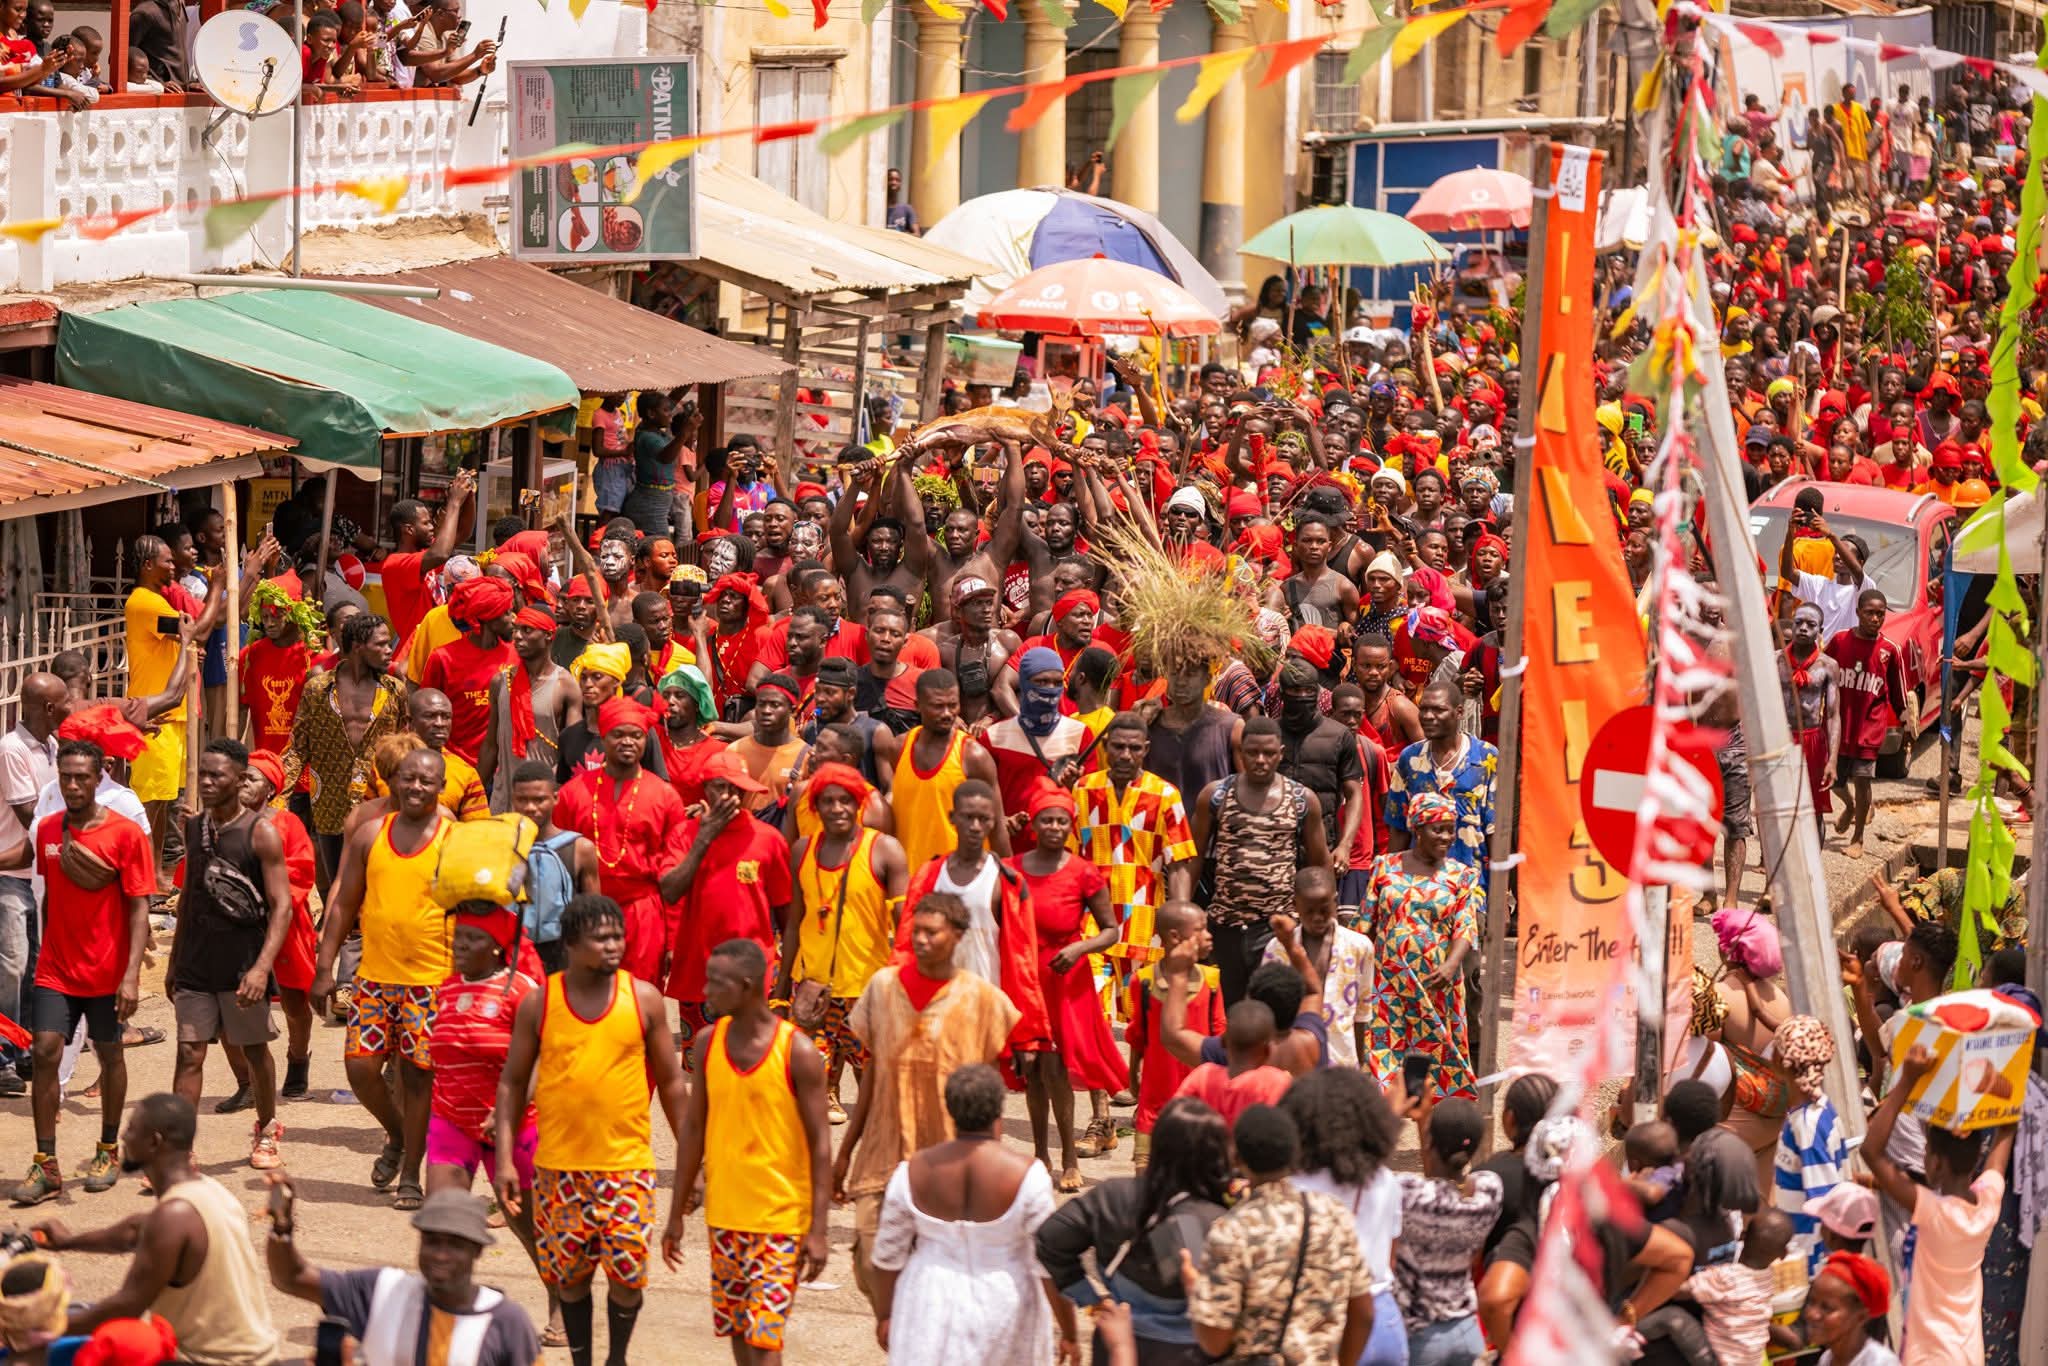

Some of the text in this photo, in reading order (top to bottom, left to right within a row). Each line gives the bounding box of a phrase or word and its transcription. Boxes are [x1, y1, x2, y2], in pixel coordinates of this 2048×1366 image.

[264, 491, 289, 501] MTN
[1523, 924, 1579, 969] Enter
[1580, 926, 1621, 962] The
